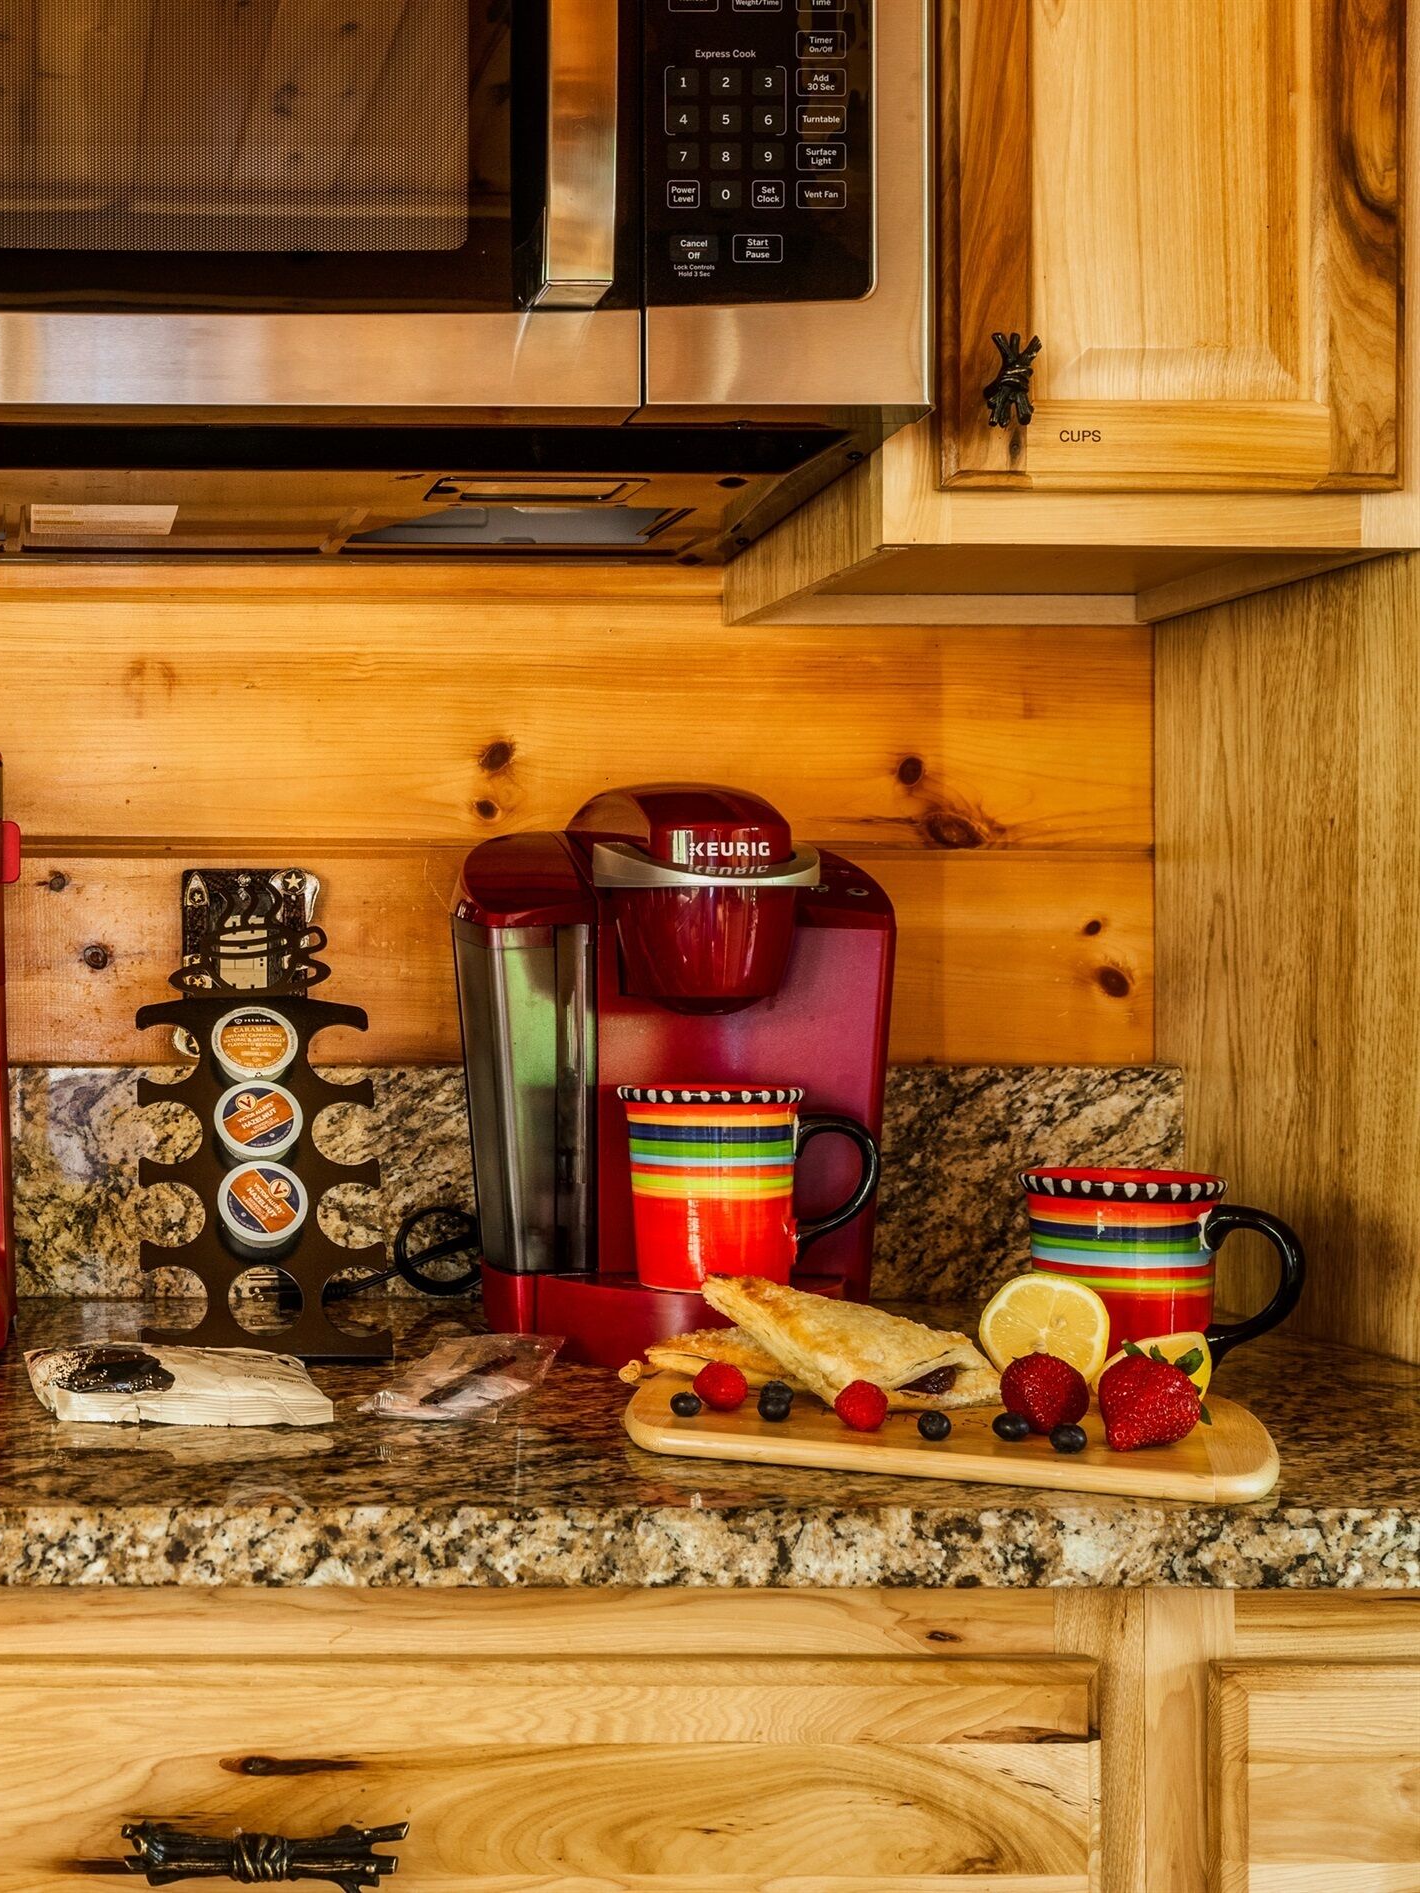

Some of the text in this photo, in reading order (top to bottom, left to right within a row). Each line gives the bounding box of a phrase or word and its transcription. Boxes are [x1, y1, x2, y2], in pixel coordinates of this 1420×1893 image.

[809, 36, 833, 44] Timer
[695, 49, 756, 59] Express Cook
[680, 77, 688, 88] 1
[722, 77, 730, 88] 2
[764, 77, 772, 88] 3
[813, 74, 829, 82] Add
[807, 83, 835, 91] 30 Sec
[680, 114, 688, 125] 4
[722, 114, 730, 125] 5
[764, 114, 772, 125] 6
[802, 115, 840, 123] Turntable
[680, 151, 688, 162] 7
[722, 151, 730, 162] 8
[764, 151, 772, 162] 9
[806, 148, 837, 156] Surface
[811, 156, 831, 166] Light
[671, 186, 696, 194] Power
[721, 189, 730, 200] 0
[761, 186, 776, 194] Set
[804, 190, 839, 199] Vent Fan
[673, 195, 694, 203] Level
[757, 195, 780, 203] Clock
[680, 239, 708, 248] Cancel
[747, 238, 769, 247] Start
[688, 251, 701, 260] Off
[746, 251, 770, 259] Pause
[1059, 430, 1102, 443] CUPS
[689, 842, 770, 856] KEURIG
[237, 1112, 256, 1123] VICTOR
[241, 1107, 277, 1129] HAZELNUT
[246, 1186, 278, 1217] HAZELNUT
